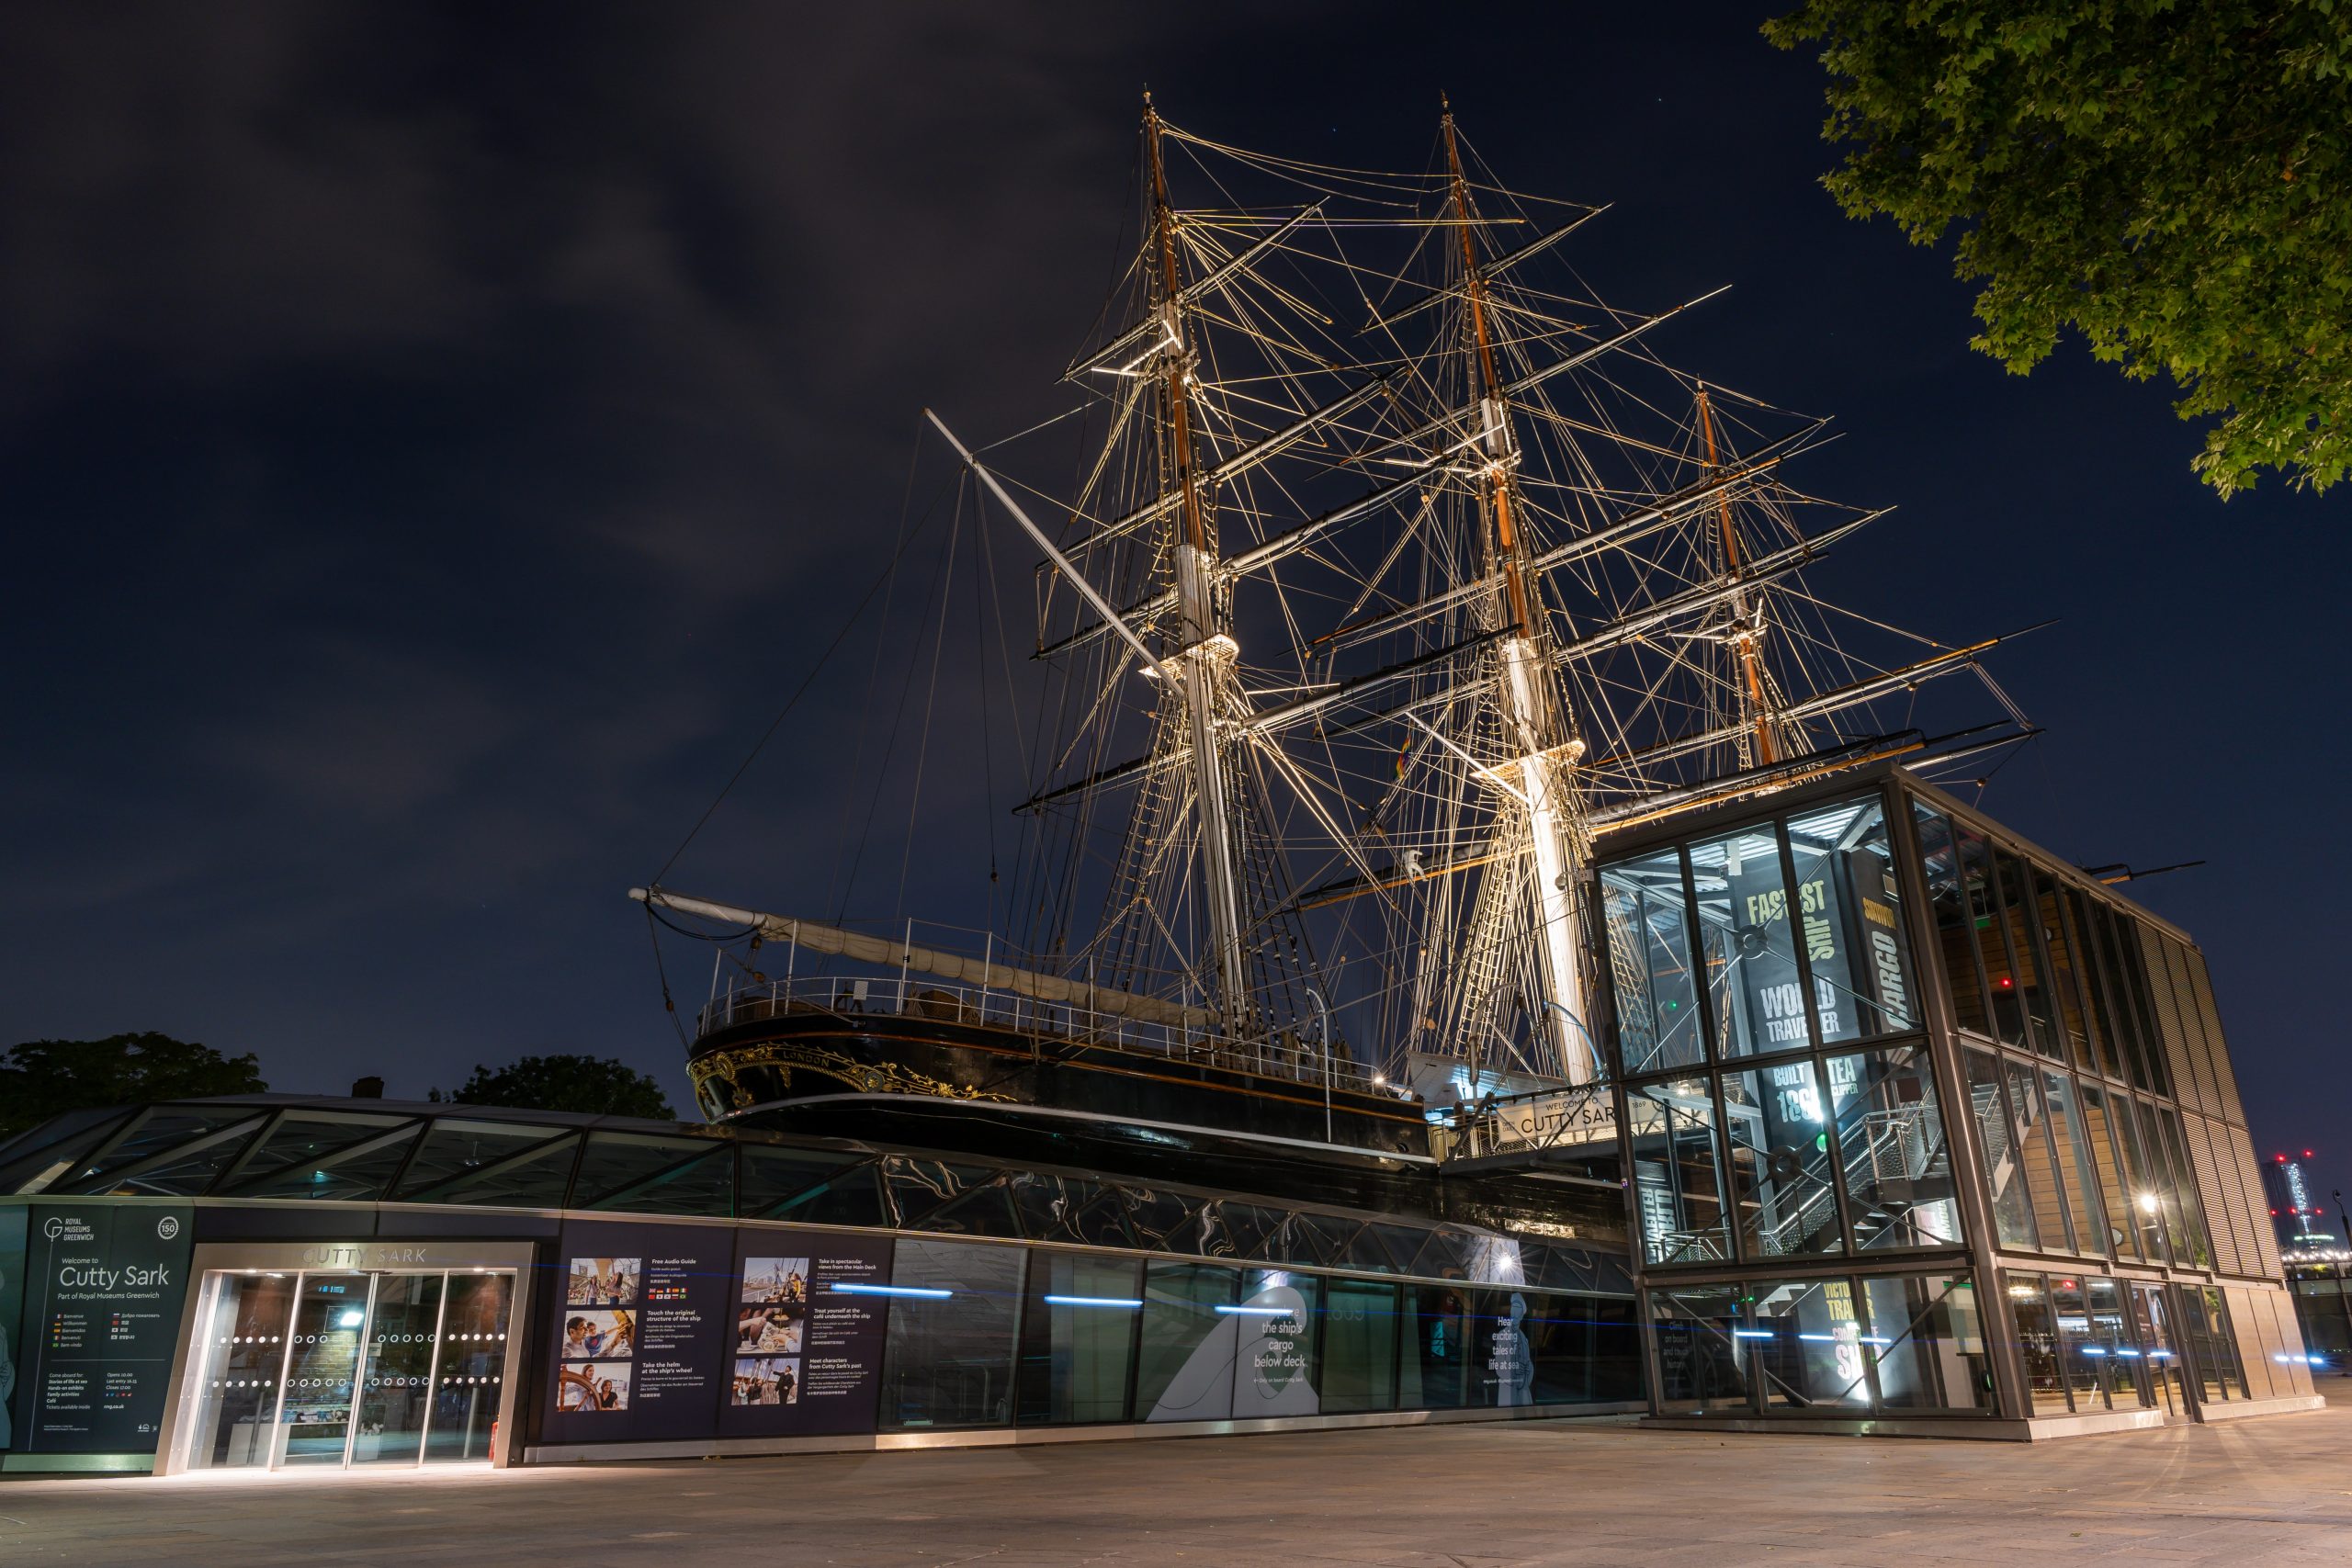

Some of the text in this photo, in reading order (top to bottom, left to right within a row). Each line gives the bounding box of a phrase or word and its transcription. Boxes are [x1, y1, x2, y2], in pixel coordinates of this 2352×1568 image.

[1871, 931, 1913, 1030] CARGO
[1766, 1011, 1840, 1043] TRAVEER
[783, 1051, 830, 1067] LONDON
[1773, 1065, 1804, 1087] BUILT
[1826, 1058, 1856, 1084] TEA
[1587, 1097, 1599, 1105] TO
[1521, 1111, 1574, 1133] CUTTY
[1583, 1106, 1616, 1124] SAR
[162, 1224, 175, 1233] 150
[302, 1248, 426, 1264] CUTTY SARK
[60, 1263, 169, 1291] Cutty Sark
[78, 1292, 96, 1301] Royal
[1498, 1316, 1514, 1326] Hear
[1261, 1321, 1303, 1336] the ship's
[1492, 1330, 1518, 1343] exciting
[1269, 1340, 1294, 1353] cargo
[1492, 1344, 1518, 1355] tales of
[1254, 1354, 1305, 1368] below deck
[1488, 1359, 1498, 1371] life
[1499, 1360, 1507, 1370] at
